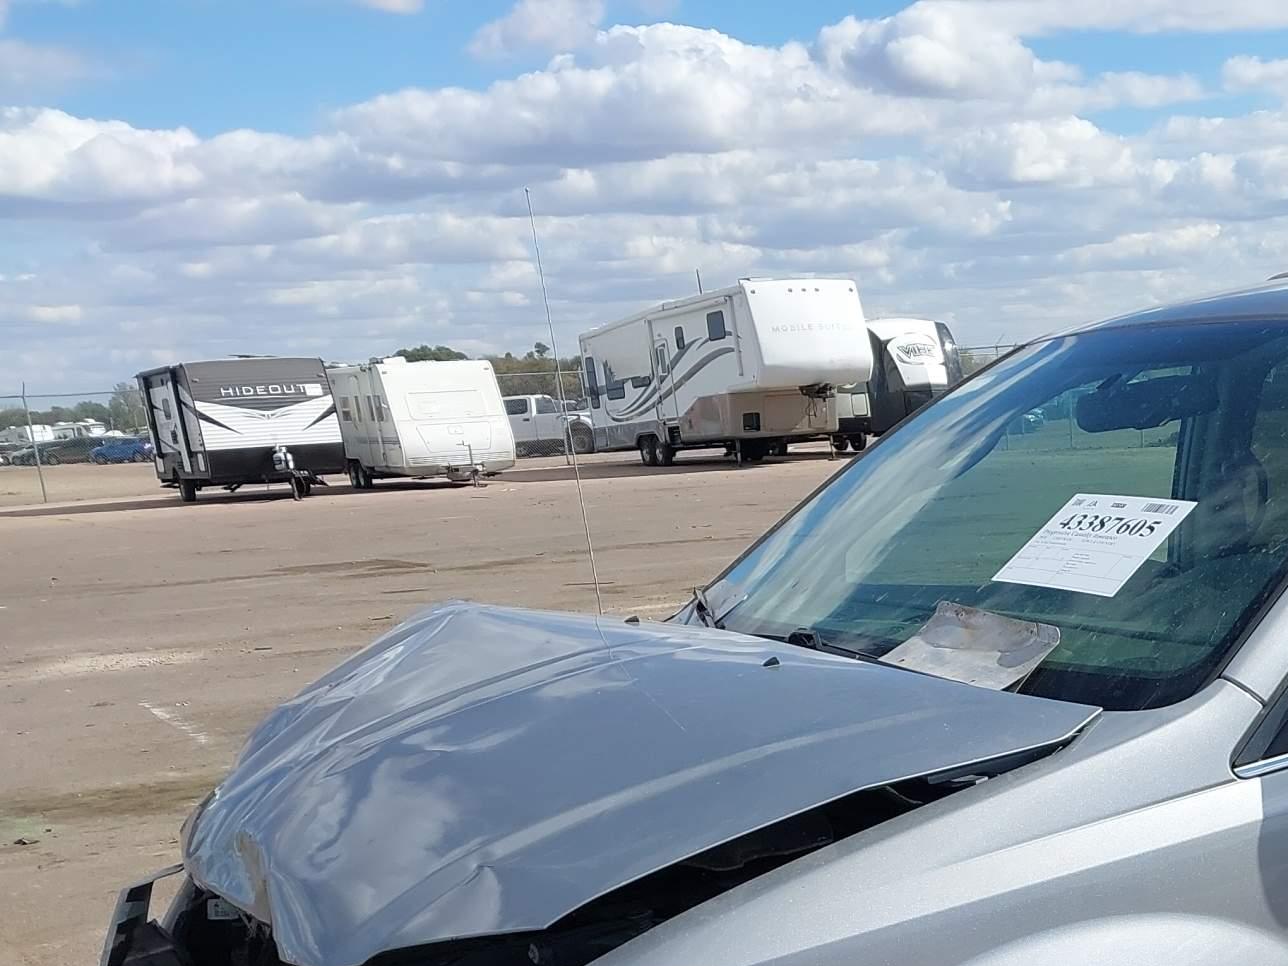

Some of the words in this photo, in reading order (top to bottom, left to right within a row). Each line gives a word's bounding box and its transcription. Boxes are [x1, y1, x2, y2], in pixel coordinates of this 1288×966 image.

[771, 323, 814, 334] MOBILE
[220, 383, 306, 398] HIDEOUT
[1059, 512, 1163, 537] 43387605
